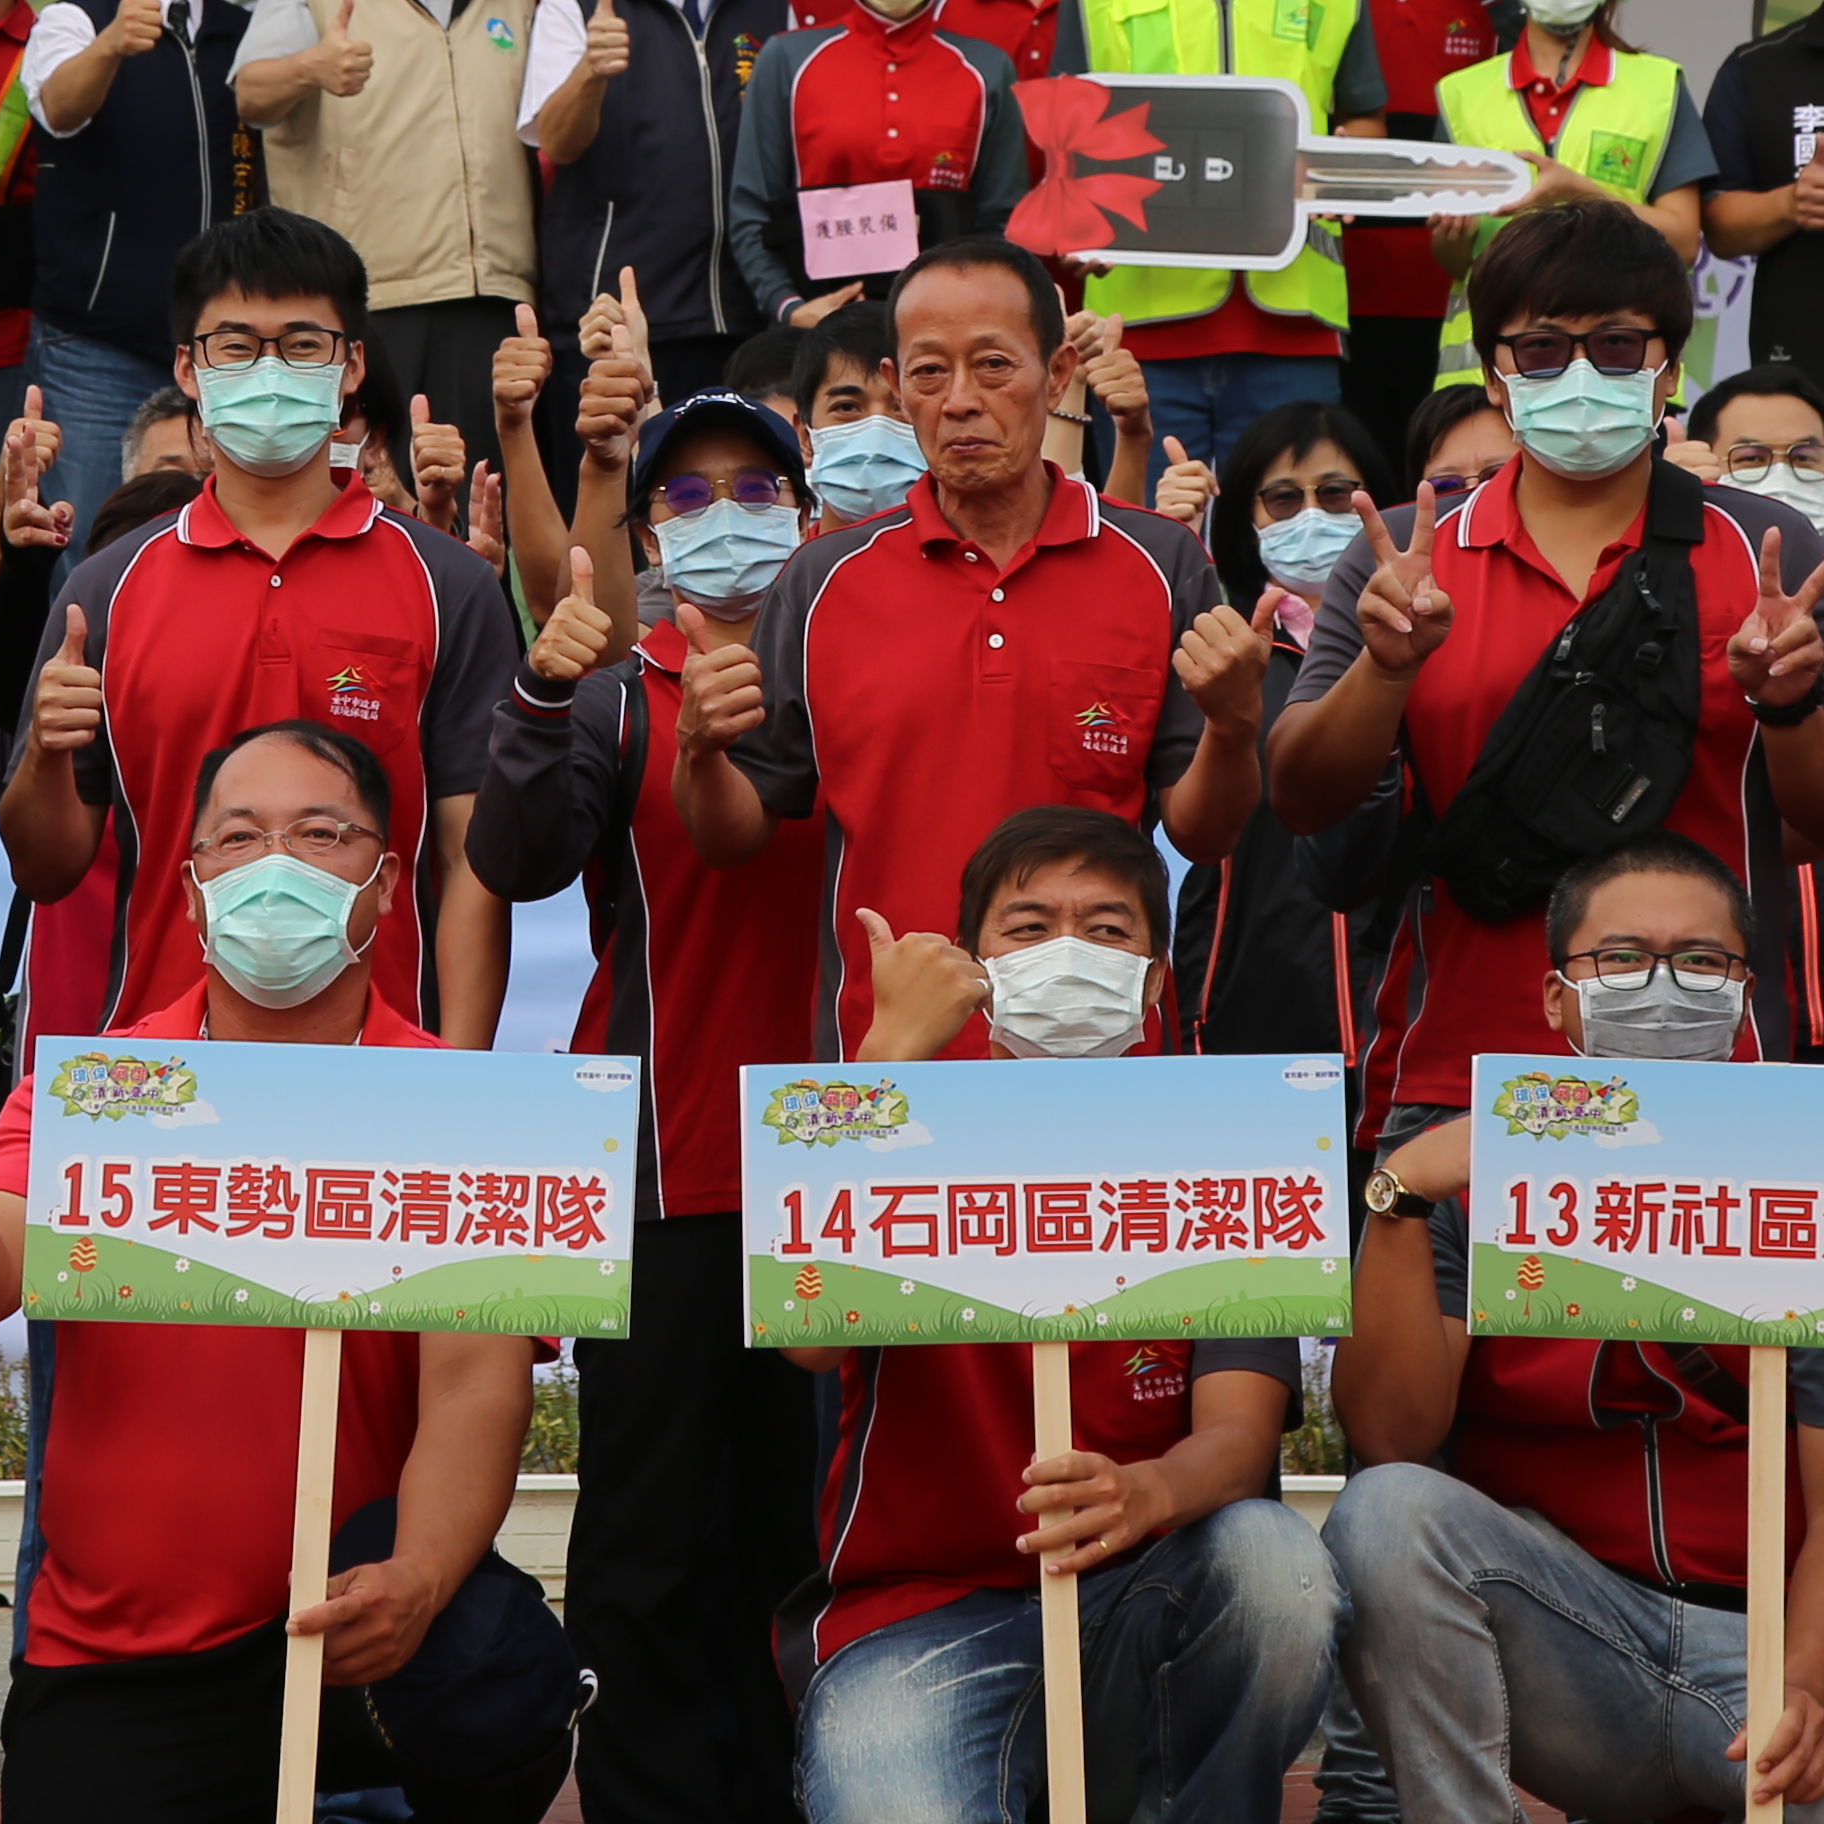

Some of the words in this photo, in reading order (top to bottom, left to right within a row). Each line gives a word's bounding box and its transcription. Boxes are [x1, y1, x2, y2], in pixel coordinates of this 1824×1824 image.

[58, 1161, 607, 1250] 15東勢區清潔隊
[781, 1175, 1326, 1258] 14石岡區清潔隊
